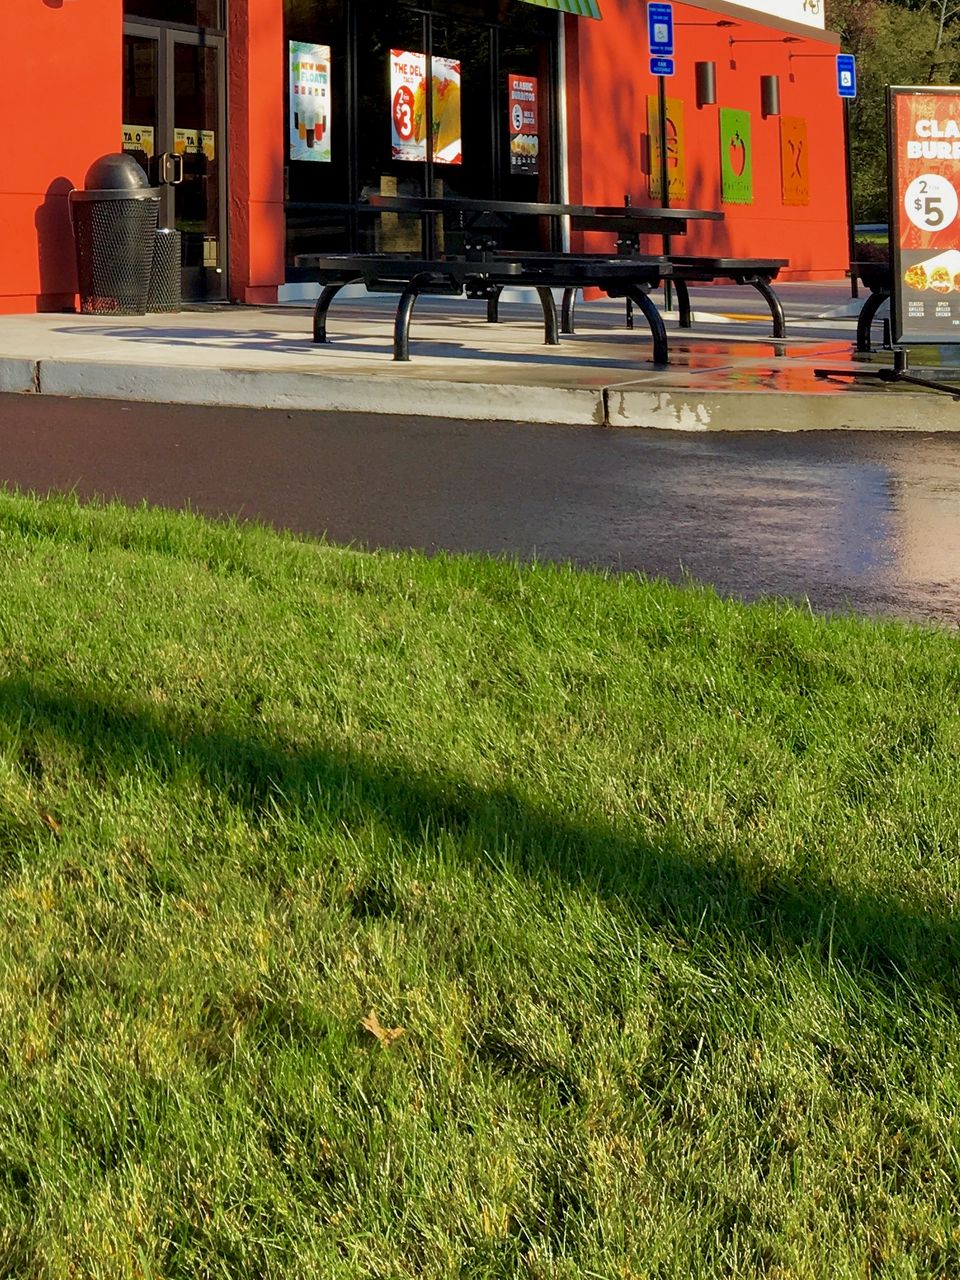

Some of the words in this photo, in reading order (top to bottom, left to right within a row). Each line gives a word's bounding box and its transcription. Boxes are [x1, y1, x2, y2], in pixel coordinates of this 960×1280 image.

[394, 62, 408, 75] THE
[410, 65, 422, 77] DEL
[396, 103, 411, 136] $3
[919, 181, 928, 193] 2
[914, 197, 944, 226] $5
